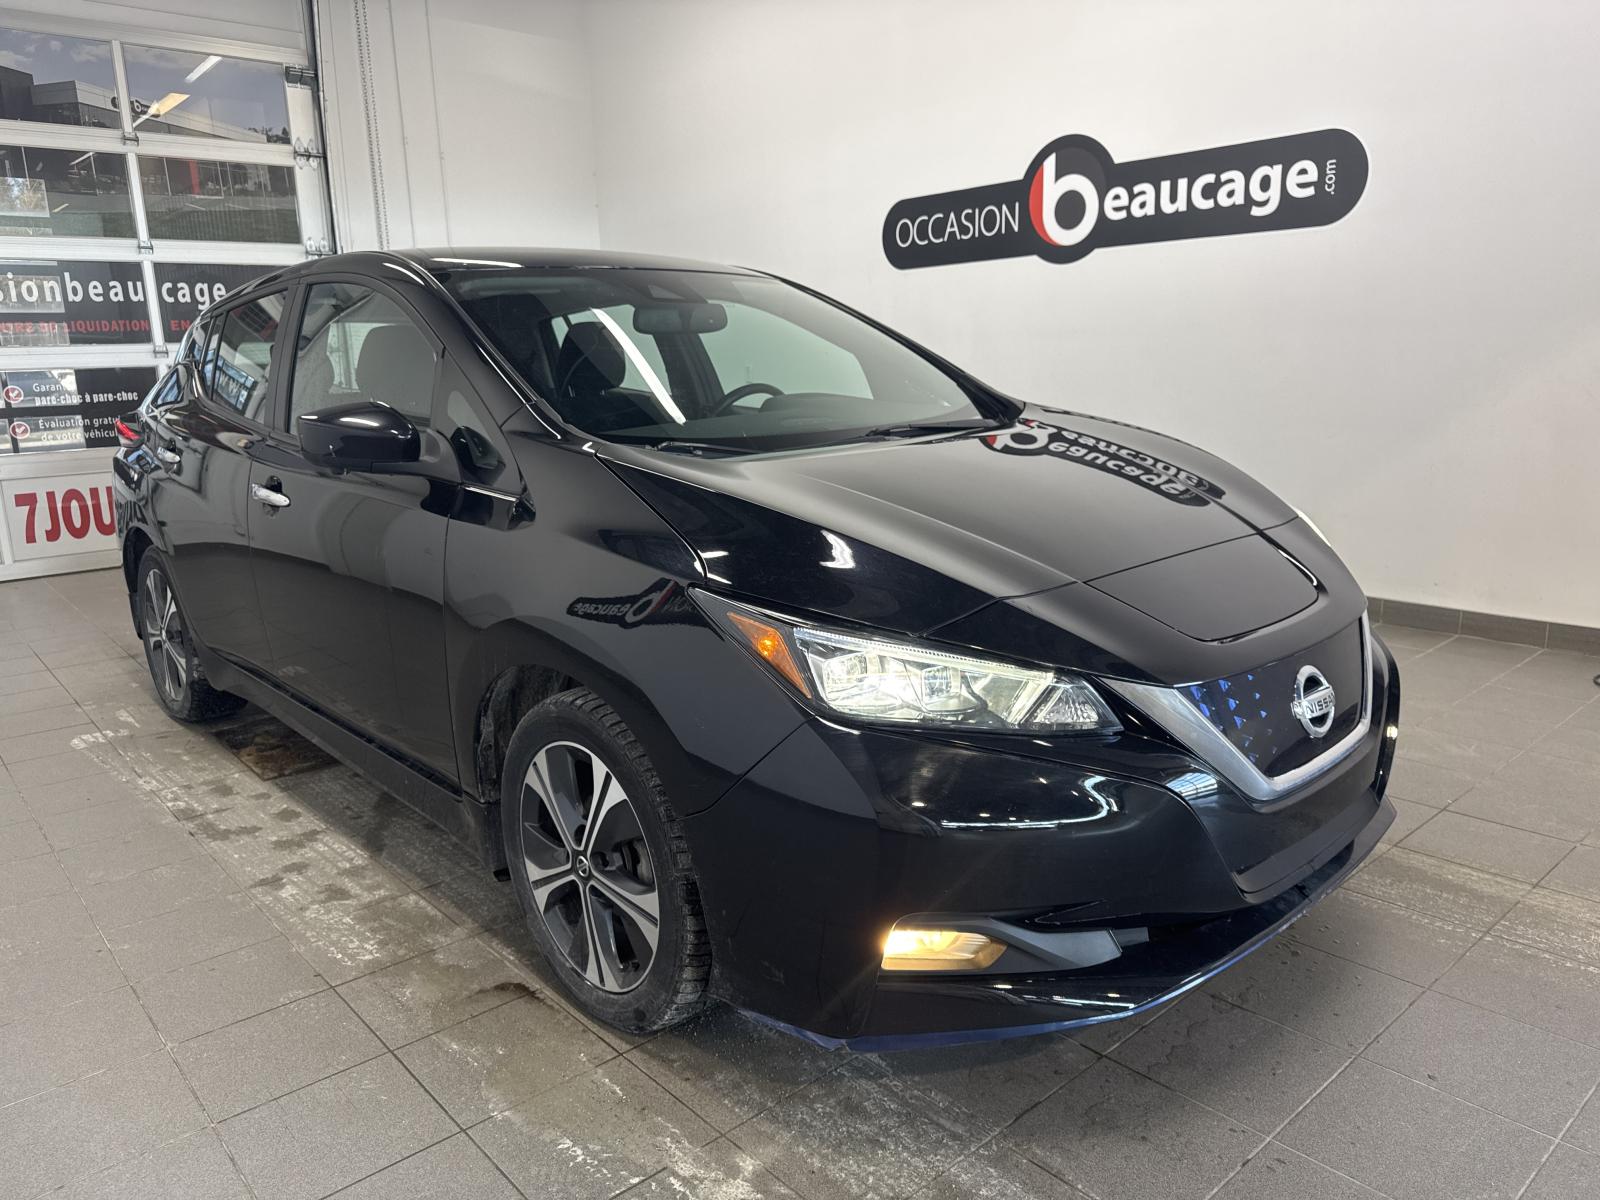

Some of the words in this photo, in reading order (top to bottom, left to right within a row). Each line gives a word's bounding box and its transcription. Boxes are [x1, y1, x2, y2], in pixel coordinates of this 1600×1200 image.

[895, 201, 1020, 248] OCCASION
[1324, 158, 1337, 195] .com
[63, 320, 150, 334] LIQUIDATION
[85, 391, 91, 403] à
[93, 390, 139, 405] pare-choc
[39, 416, 90, 429] Évaluation
[93, 415, 120, 427] gratu
[84, 428, 118, 439] véhicul
[45, 485, 116, 543] JOU
